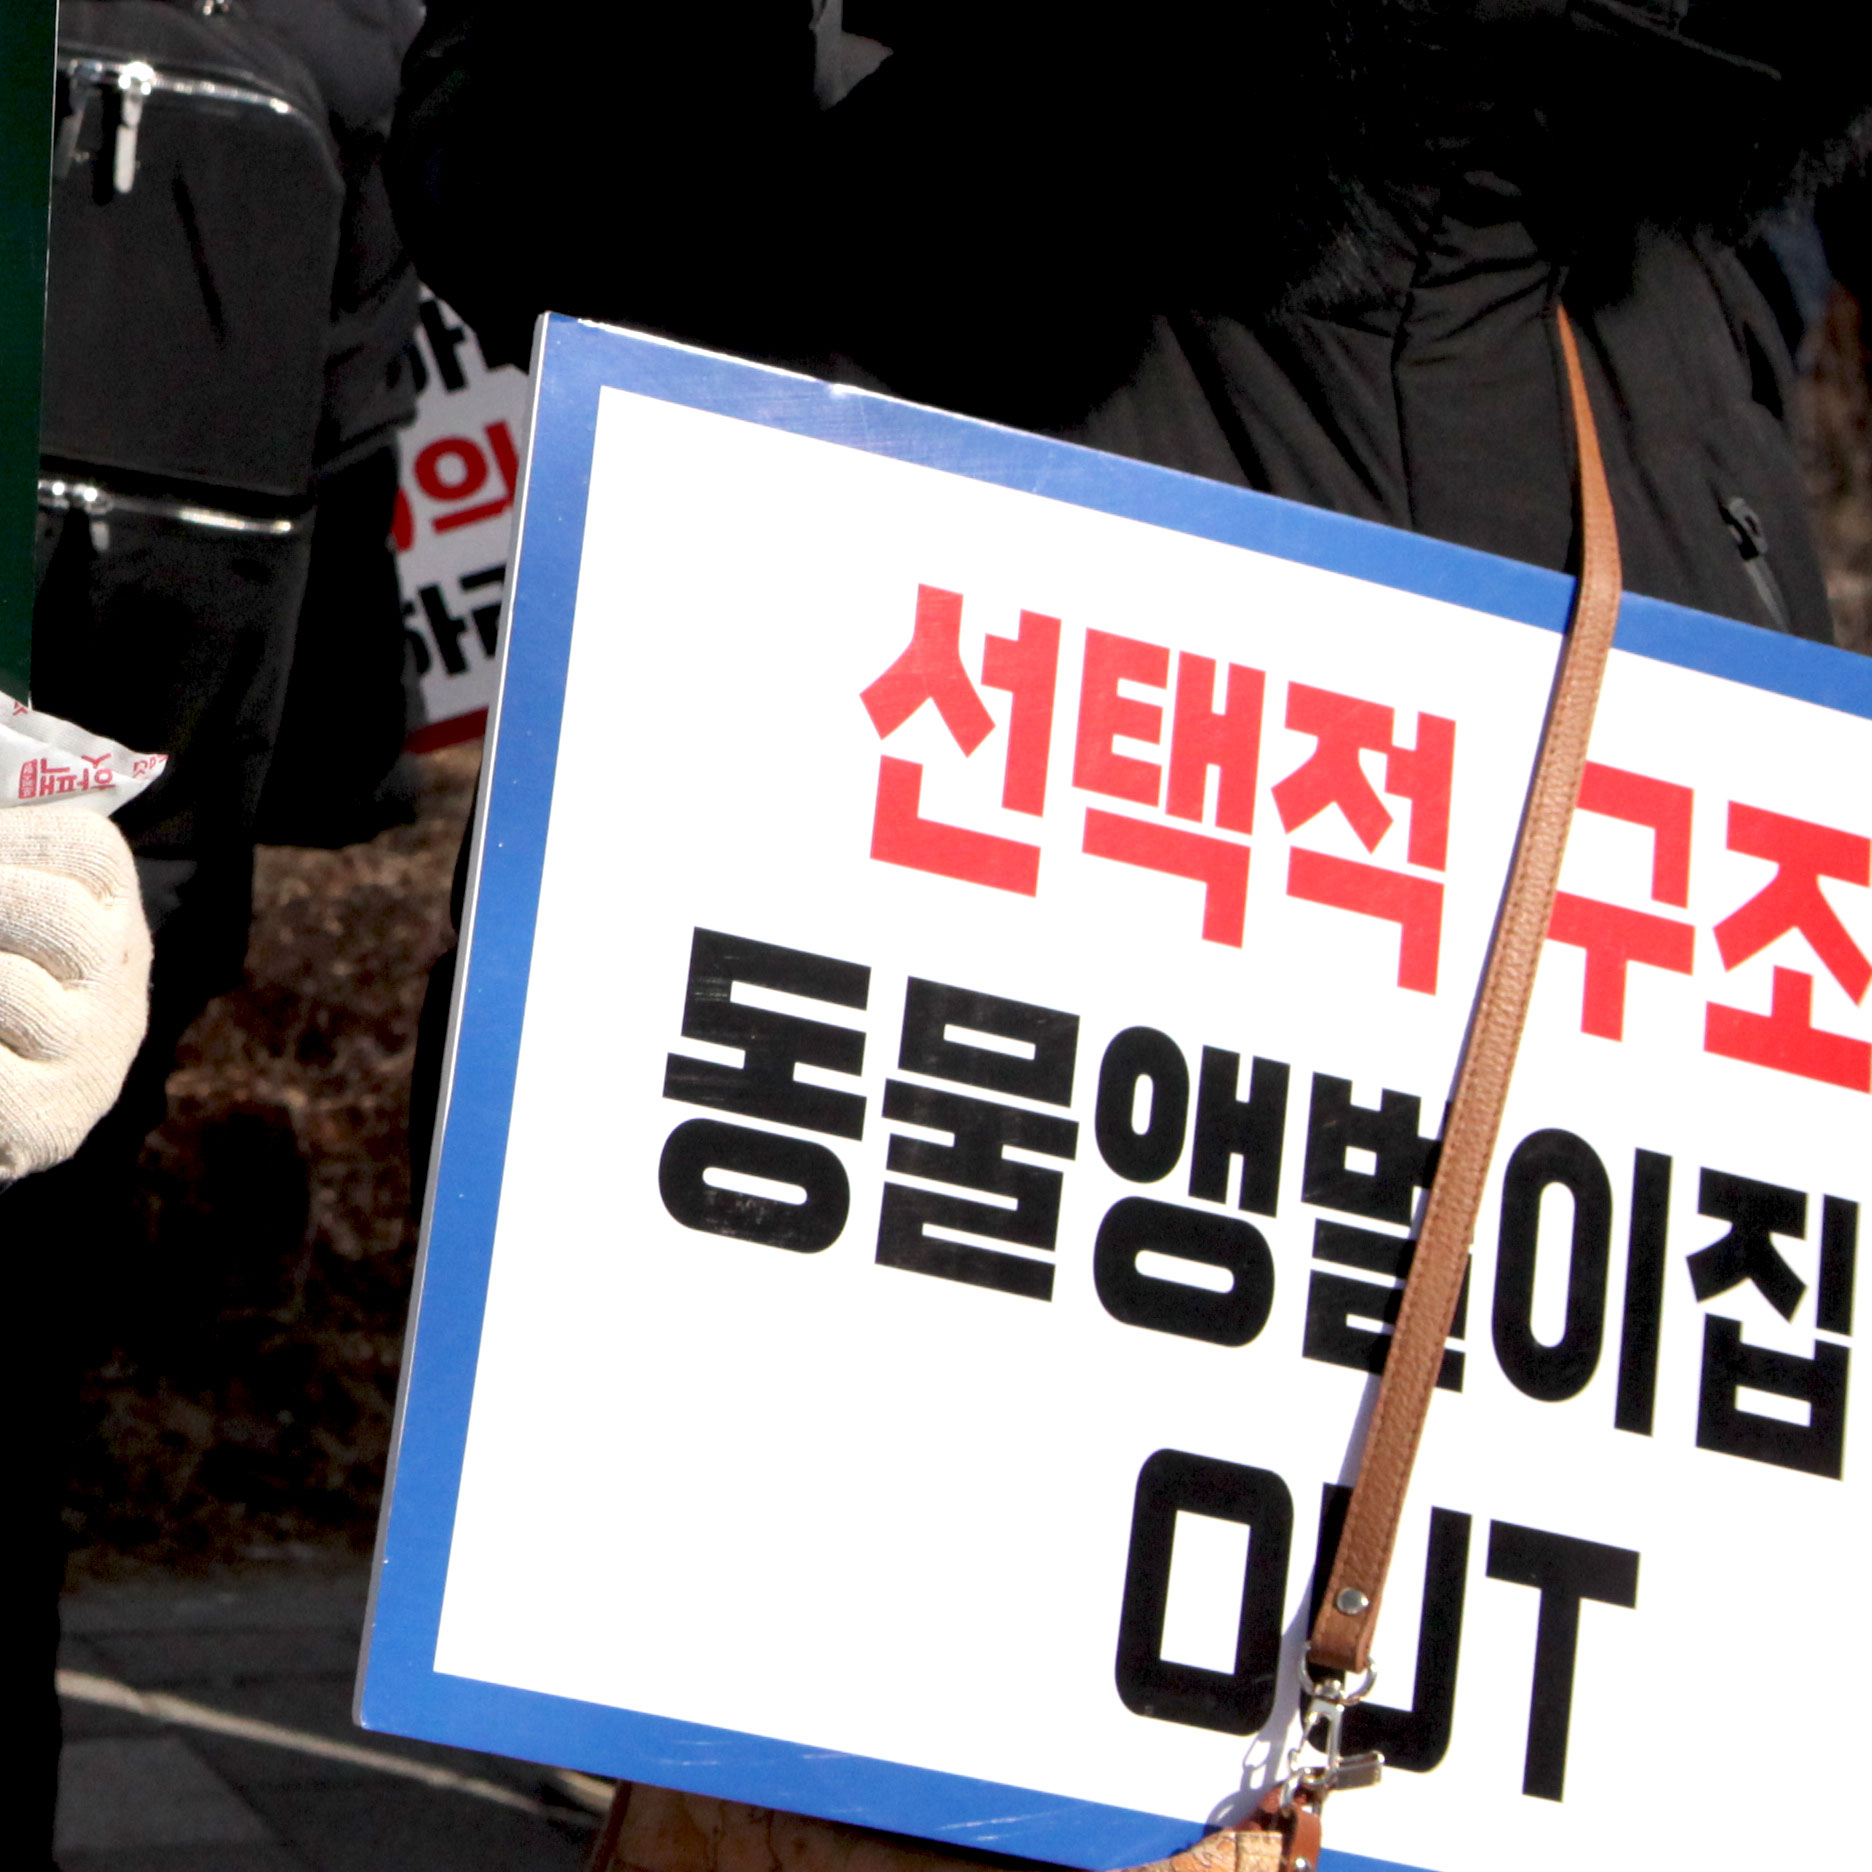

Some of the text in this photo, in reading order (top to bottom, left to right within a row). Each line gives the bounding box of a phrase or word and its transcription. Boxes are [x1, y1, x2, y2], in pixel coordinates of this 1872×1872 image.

[39, 753, 117, 797] 핫팩
[859, 583, 1458, 996] 선택적
[659, 928, 1860, 1482] 동물앵벌이집
[1115, 1448, 1641, 1802] OUT
